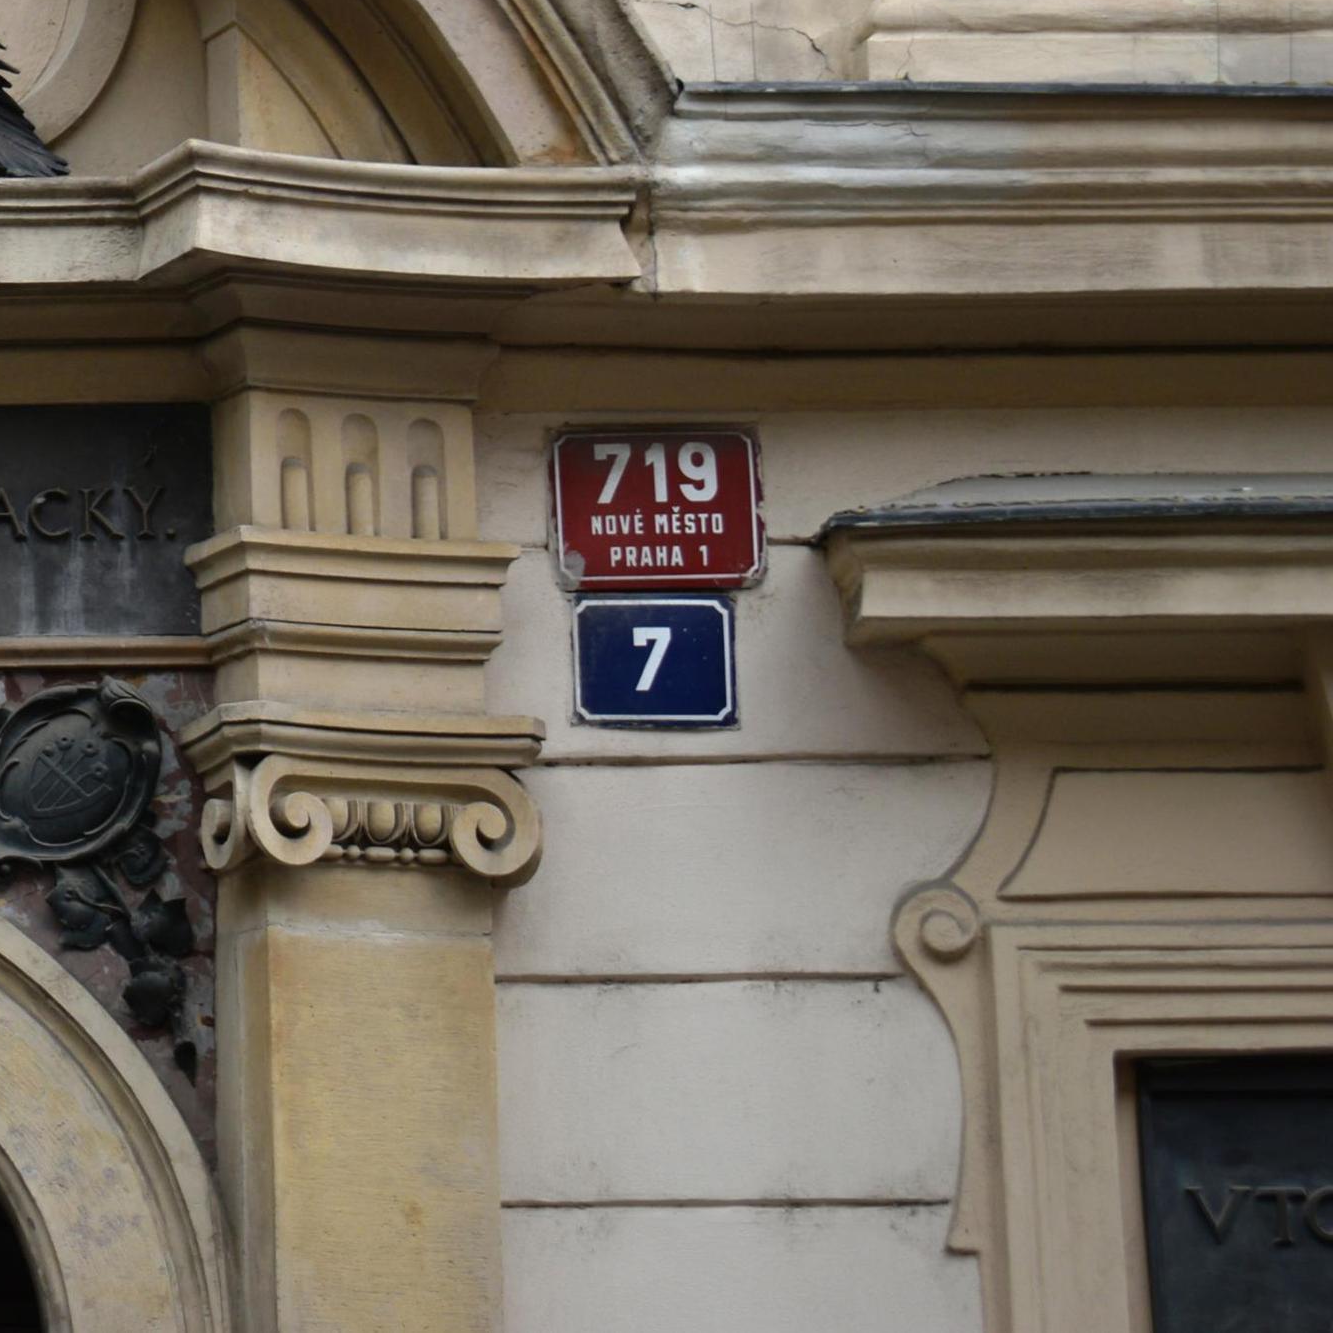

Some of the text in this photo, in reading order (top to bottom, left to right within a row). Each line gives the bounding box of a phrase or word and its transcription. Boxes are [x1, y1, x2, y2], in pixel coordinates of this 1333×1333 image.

[593, 441, 720, 504] 719
[590, 506, 724, 536] NOVÉ MĚSTO
[609, 544, 710, 567] PRAHA 1
[633, 626, 672, 692] 7
